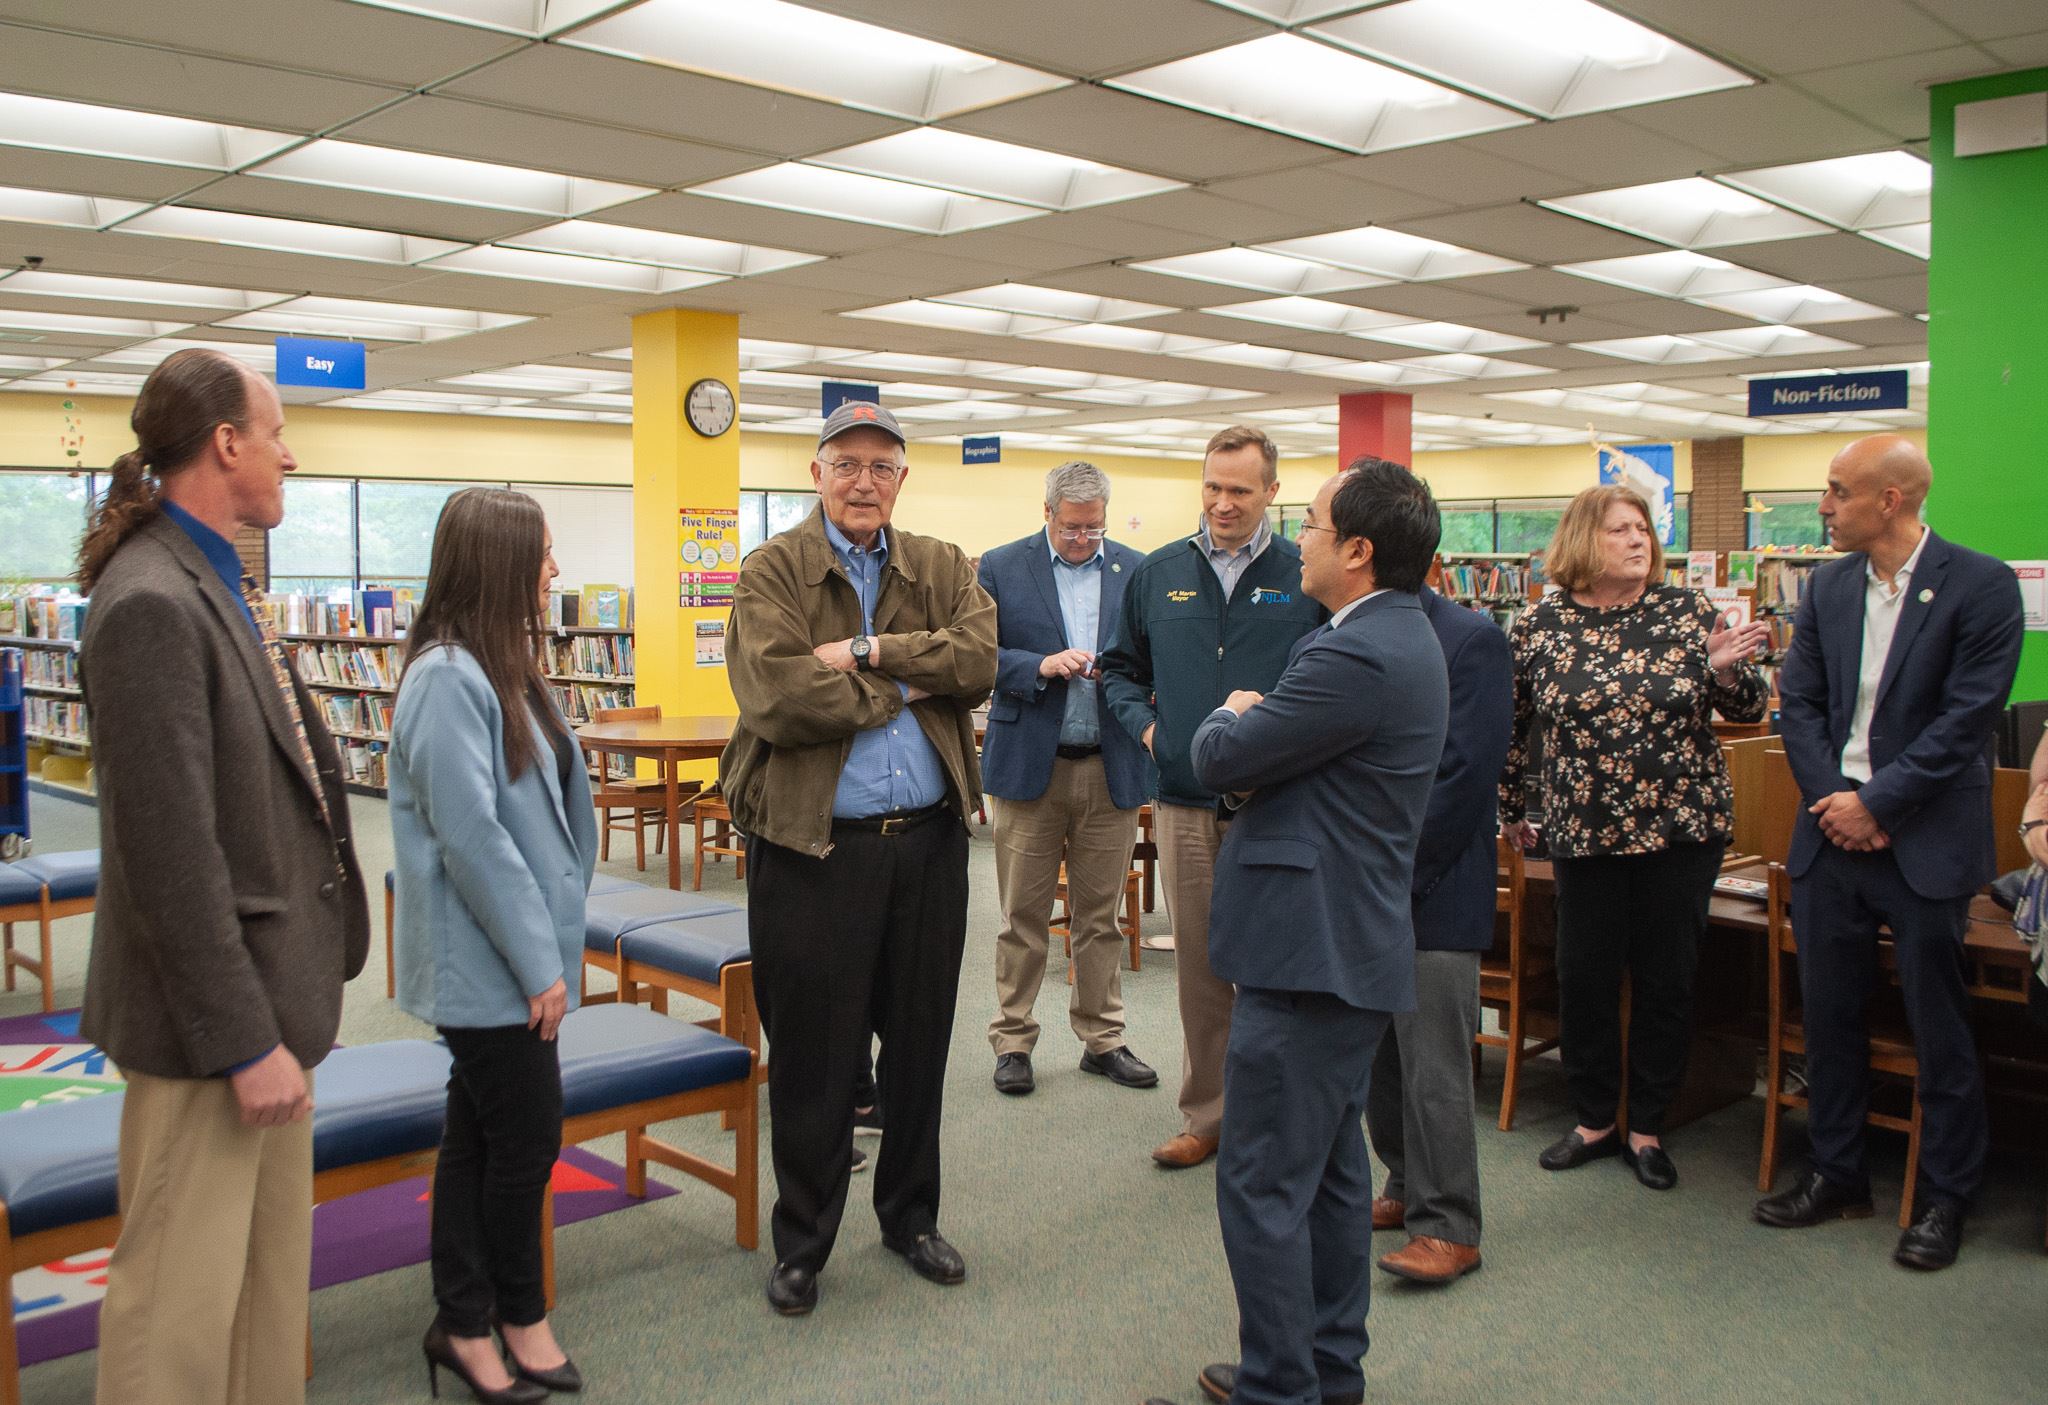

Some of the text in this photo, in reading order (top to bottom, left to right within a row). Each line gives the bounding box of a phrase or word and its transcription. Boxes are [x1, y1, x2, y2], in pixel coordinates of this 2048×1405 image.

[306, 356, 335, 375] Easy
[1772, 383, 1881, 405] Non-Fiction
[852, 406, 878, 420] R
[682, 516, 736, 529] Five Finger
[696, 530, 722, 540] Rule!
[1260, 592, 1290, 604] NJLM
